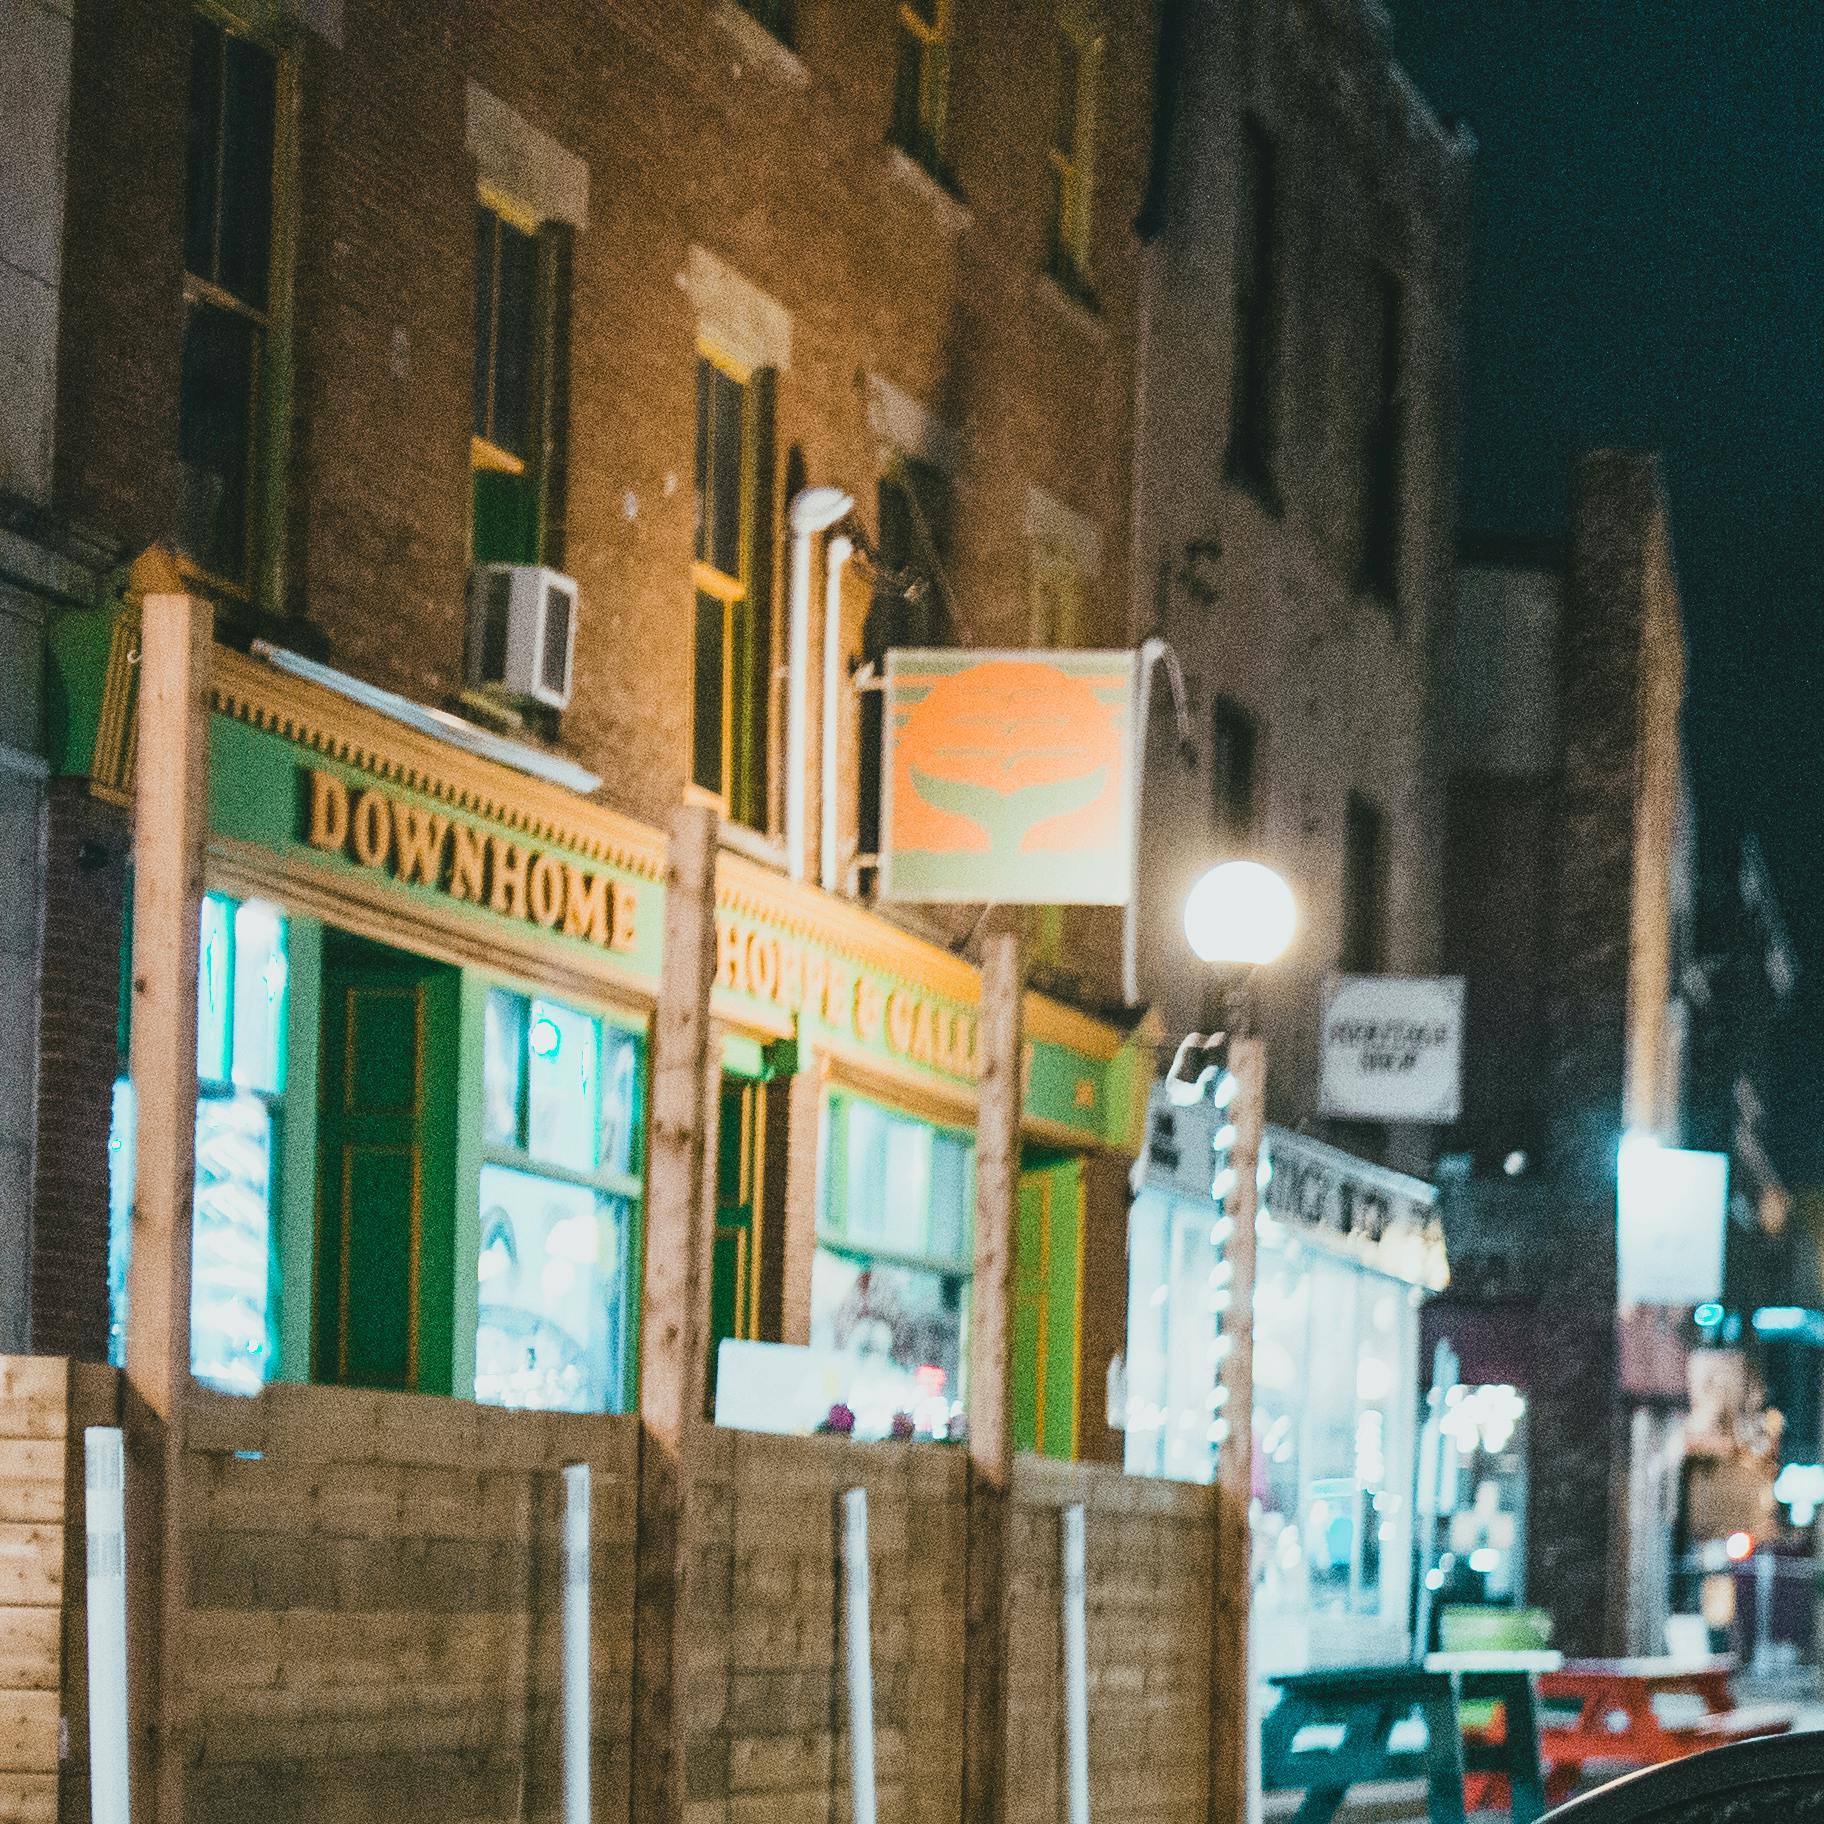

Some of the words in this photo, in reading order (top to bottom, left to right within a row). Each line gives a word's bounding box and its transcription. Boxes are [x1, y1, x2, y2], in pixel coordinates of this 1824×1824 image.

[306, 768, 636, 951] DOWNHOME
[717, 921, 849, 1027] HOPPE
[886, 987, 980, 1084] GALL
